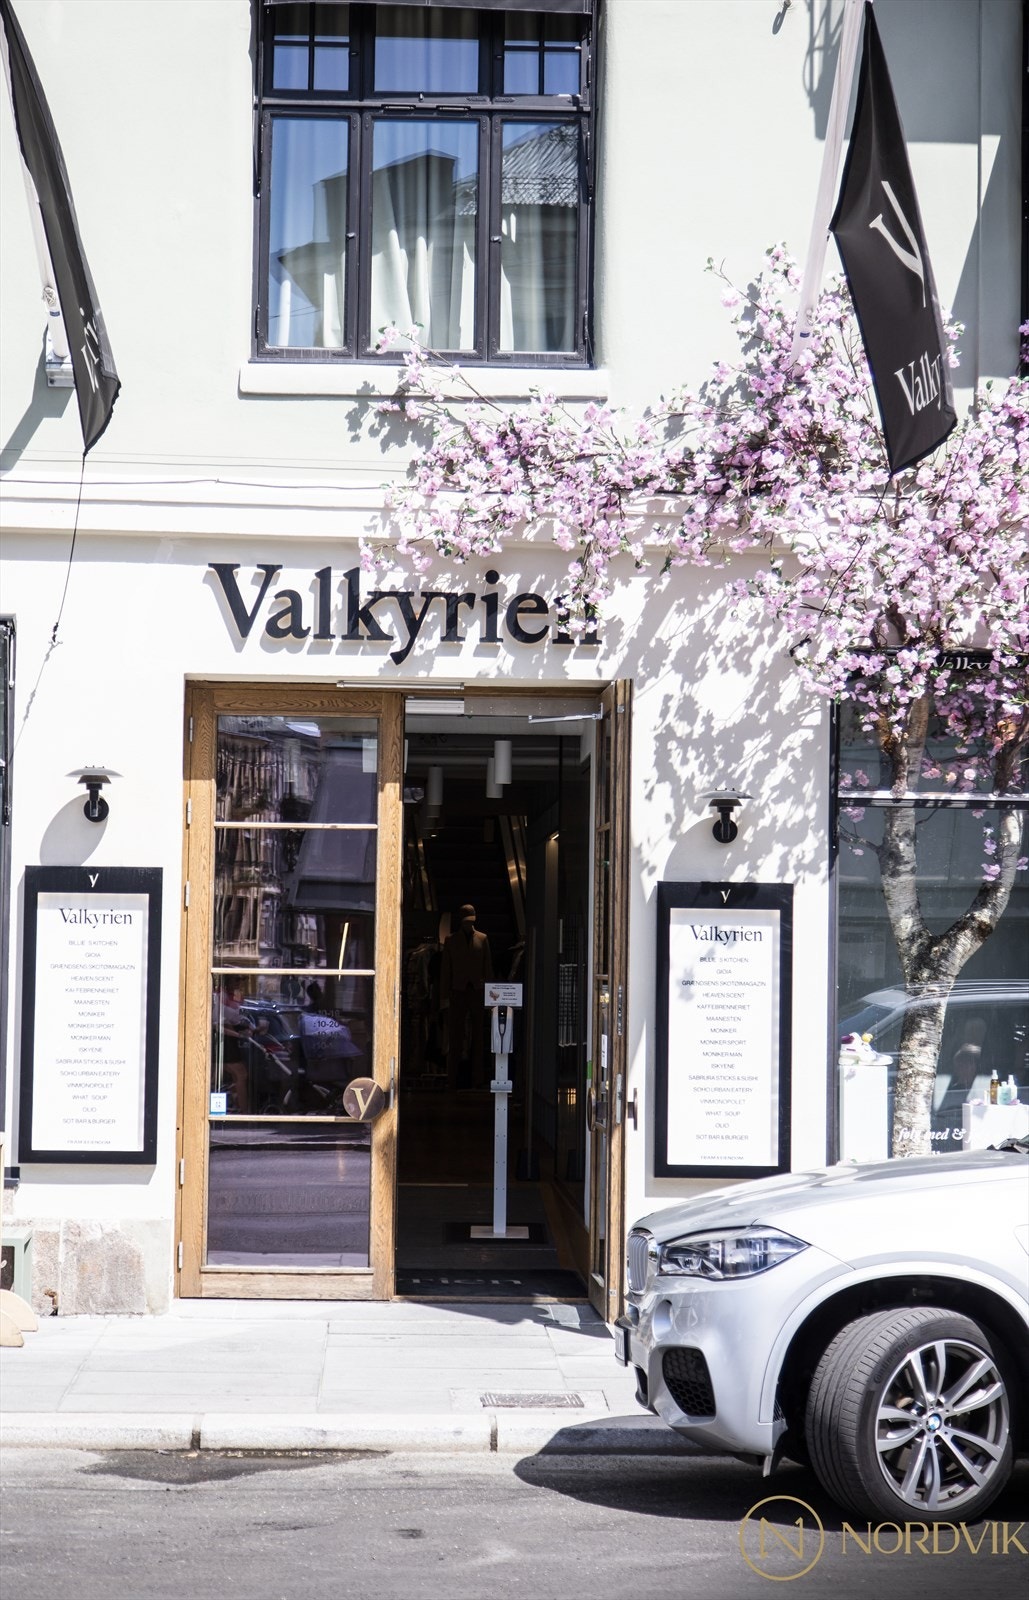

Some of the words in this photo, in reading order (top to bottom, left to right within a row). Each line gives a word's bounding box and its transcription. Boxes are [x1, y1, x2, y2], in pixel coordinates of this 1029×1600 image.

[59, 908, 133, 929] Valkyrien
[690, 924, 763, 945] Valkyrien
[952, 1128, 967, 1140] &
